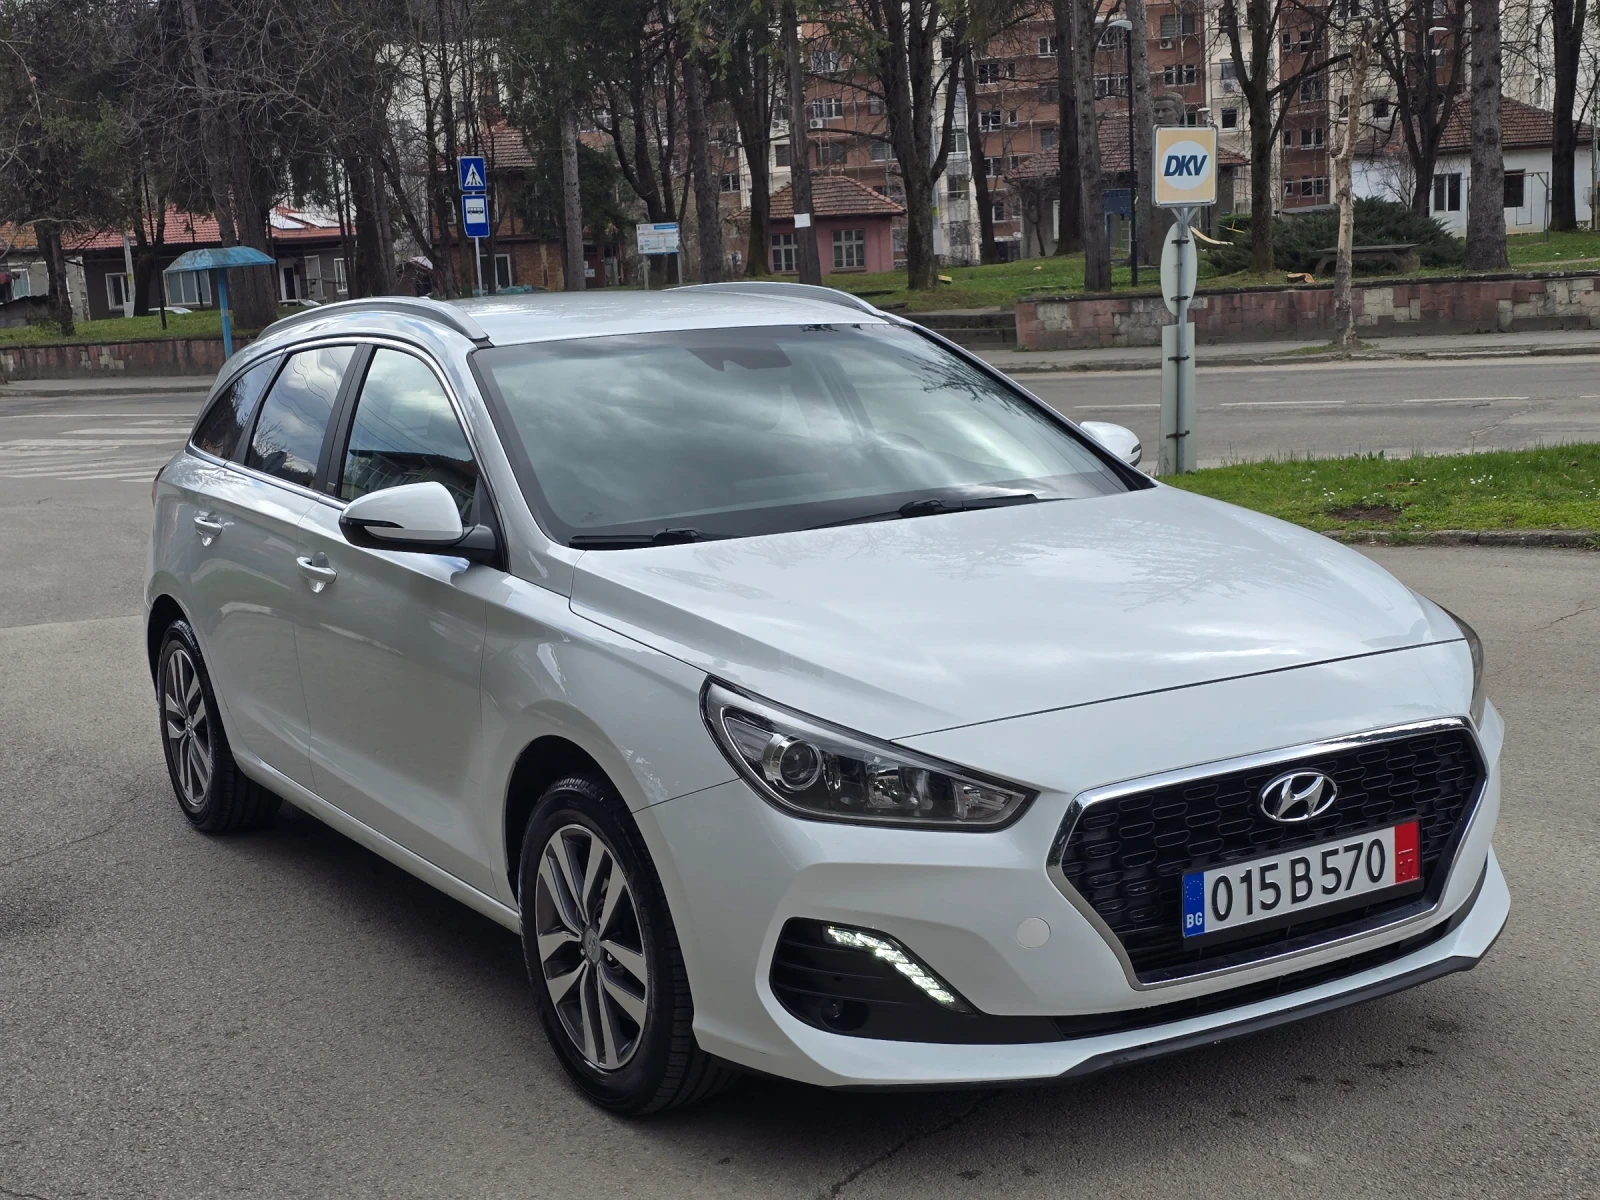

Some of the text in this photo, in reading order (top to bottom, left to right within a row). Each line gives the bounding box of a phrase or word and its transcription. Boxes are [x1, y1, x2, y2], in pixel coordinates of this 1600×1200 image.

[1164, 155, 1208, 176] DKV
[1211, 838, 1386, 922] 015B570
[1186, 912, 1203, 928] BG
